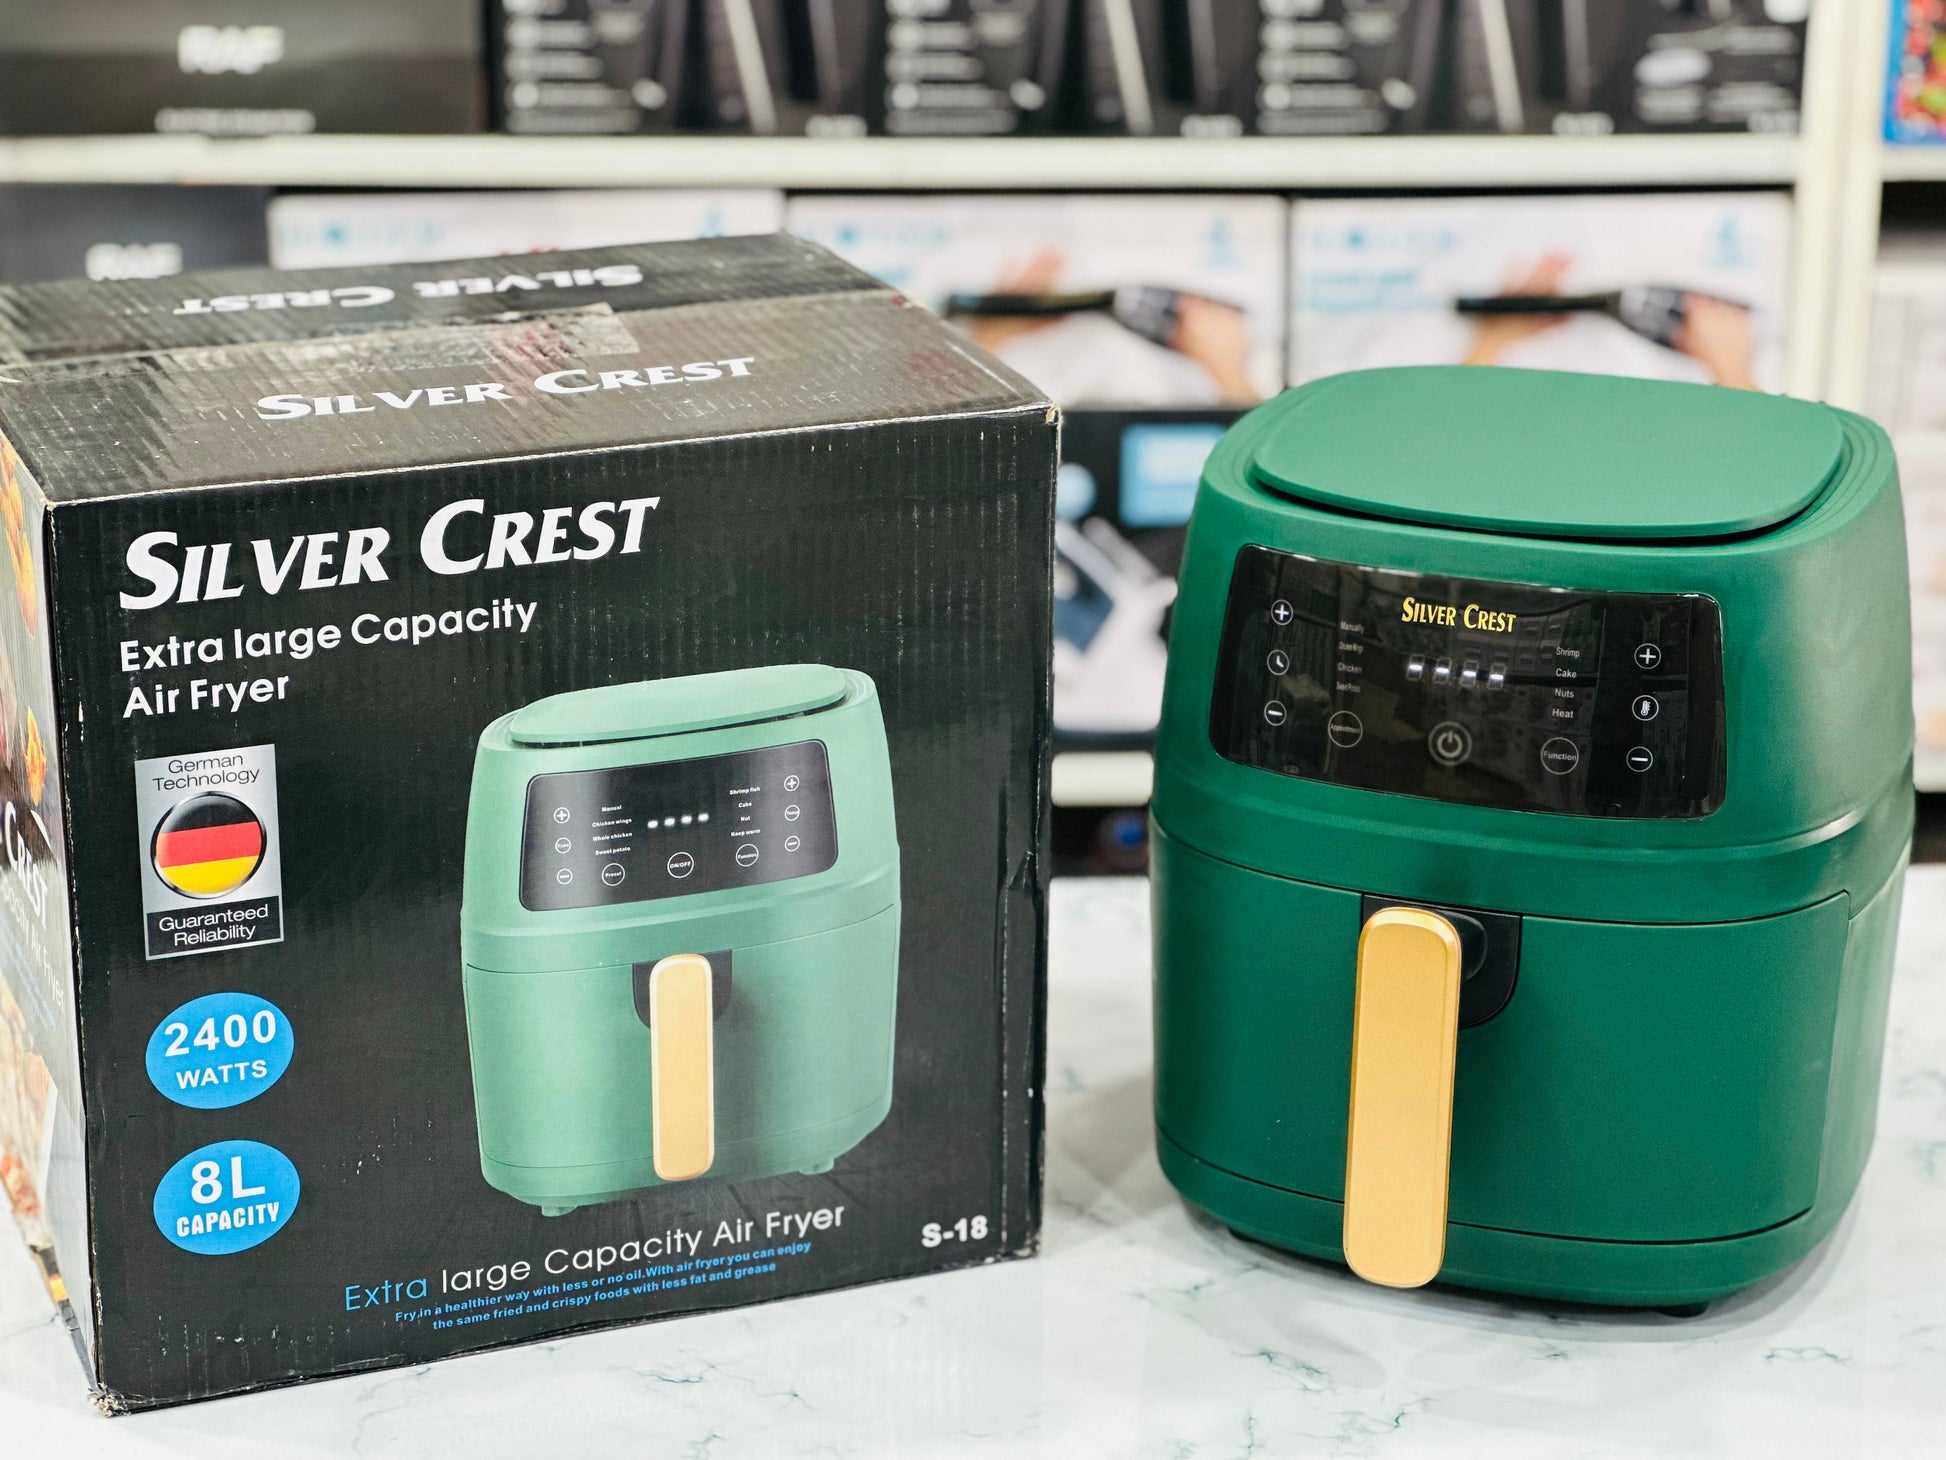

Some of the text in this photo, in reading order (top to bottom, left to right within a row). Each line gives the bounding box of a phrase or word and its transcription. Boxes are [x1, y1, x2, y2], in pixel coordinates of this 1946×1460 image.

[172, 264, 644, 315] SILVER CREST
[256, 357, 755, 421] SILVER CREST
[119, 497, 661, 610] SILVER CREST
[1402, 596, 1517, 632] SILVER CREST
[120, 597, 537, 672] Extra large Capacity
[1555, 646, 1580, 658] Shrimp
[1337, 662, 1362, 673] Chicken
[1555, 668, 1577, 679] Cake
[122, 674, 290, 719] Air Fryer
[1554, 688, 1575, 699] Nuts
[1551, 708, 1574, 719] Heat
[168, 755, 243, 774] German
[1543, 750, 1578, 761] Function
[152, 768, 260, 792] Technology
[5, 801, 48, 930] CREST
[158, 903, 269, 932] Guaranteed
[174, 925, 256, 947] Reliability
[164, 1009, 277, 1057] 2400
[176, 1059, 267, 1090] WATTS
[176, 1201, 280, 1237] CAPACITY
[921, 1214, 988, 1248] S-18
[345, 1205, 845, 1311] Extra large Capacity Air Fryer
[433, 1261, 776, 1330] the same fried and crispy foods with less fat and grease
[435, 1306, 442, 1315] a
[445, 1294, 503, 1313] healthier
[505, 1290, 530, 1302] way
[533, 1284, 560, 1297] with
[562, 1281, 588, 1292] less
[591, 1278, 605, 1287] or
[607, 1273, 623, 1283] no
[676, 1261, 692, 1272] air
[695, 1257, 725, 1271] fryer
[727, 1252, 750, 1266] you
[752, 1248, 775, 1259] can
[777, 1241, 811, 1255] enjoy
